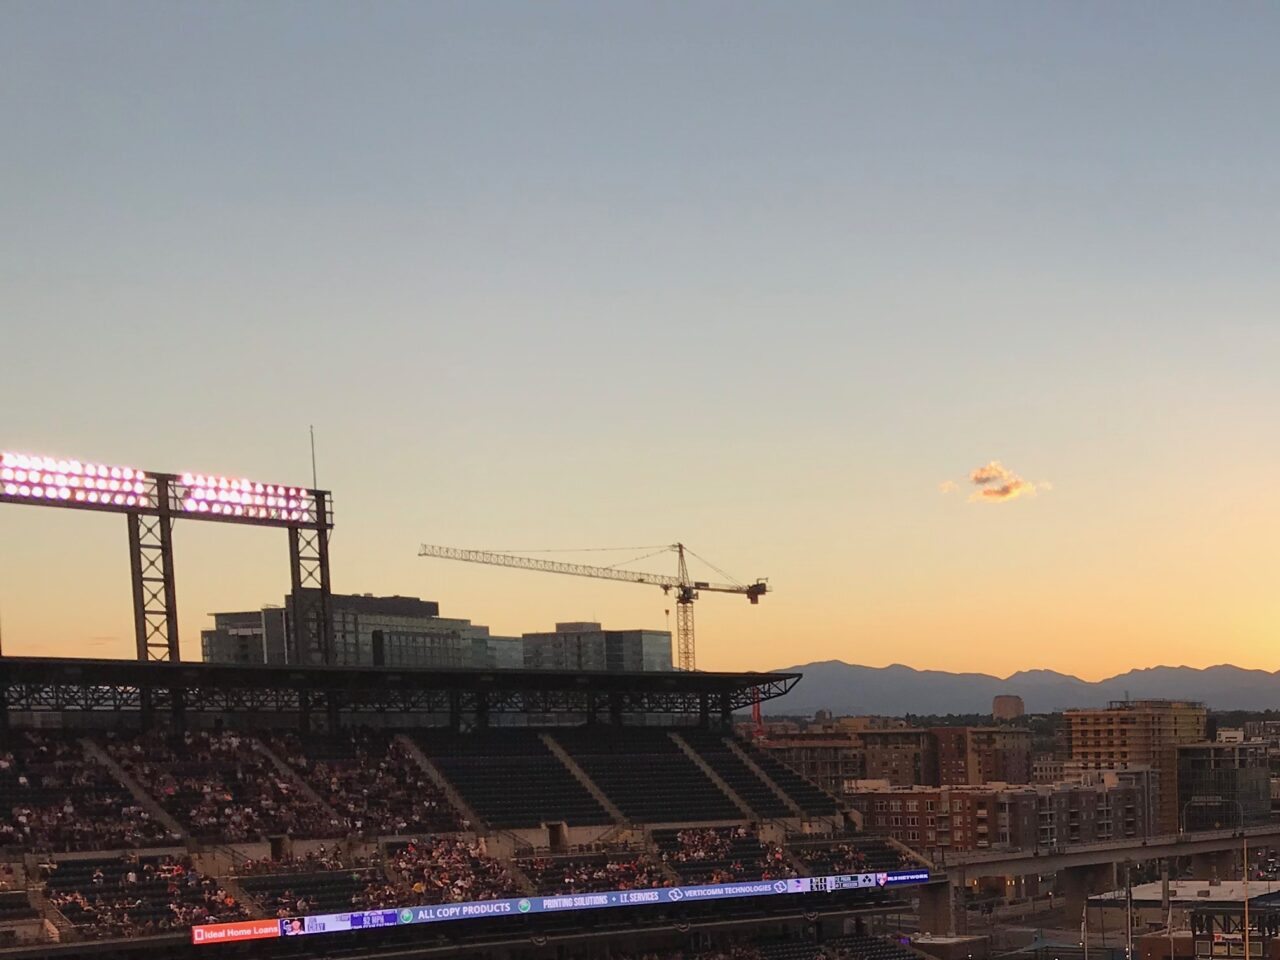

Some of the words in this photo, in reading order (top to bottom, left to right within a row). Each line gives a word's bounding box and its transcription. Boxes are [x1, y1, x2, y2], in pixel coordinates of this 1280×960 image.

[898, 873, 928, 881] NETWORK
[684, 887, 723, 898] VERTICOMM
[724, 883, 772, 896] TECHNOLOGIES
[543, 897, 572, 909] PRINTING
[573, 894, 608, 908] SOLUTIONS
[629, 891, 659, 902] SERVICES
[418, 910, 435, 920] ALL
[437, 907, 462, 919] COPY
[462, 903, 511, 916] PRODUCTS
[204, 930, 225, 939] Ideal
[227, 927, 252, 937] Home
[253, 925, 278, 935] Loans
